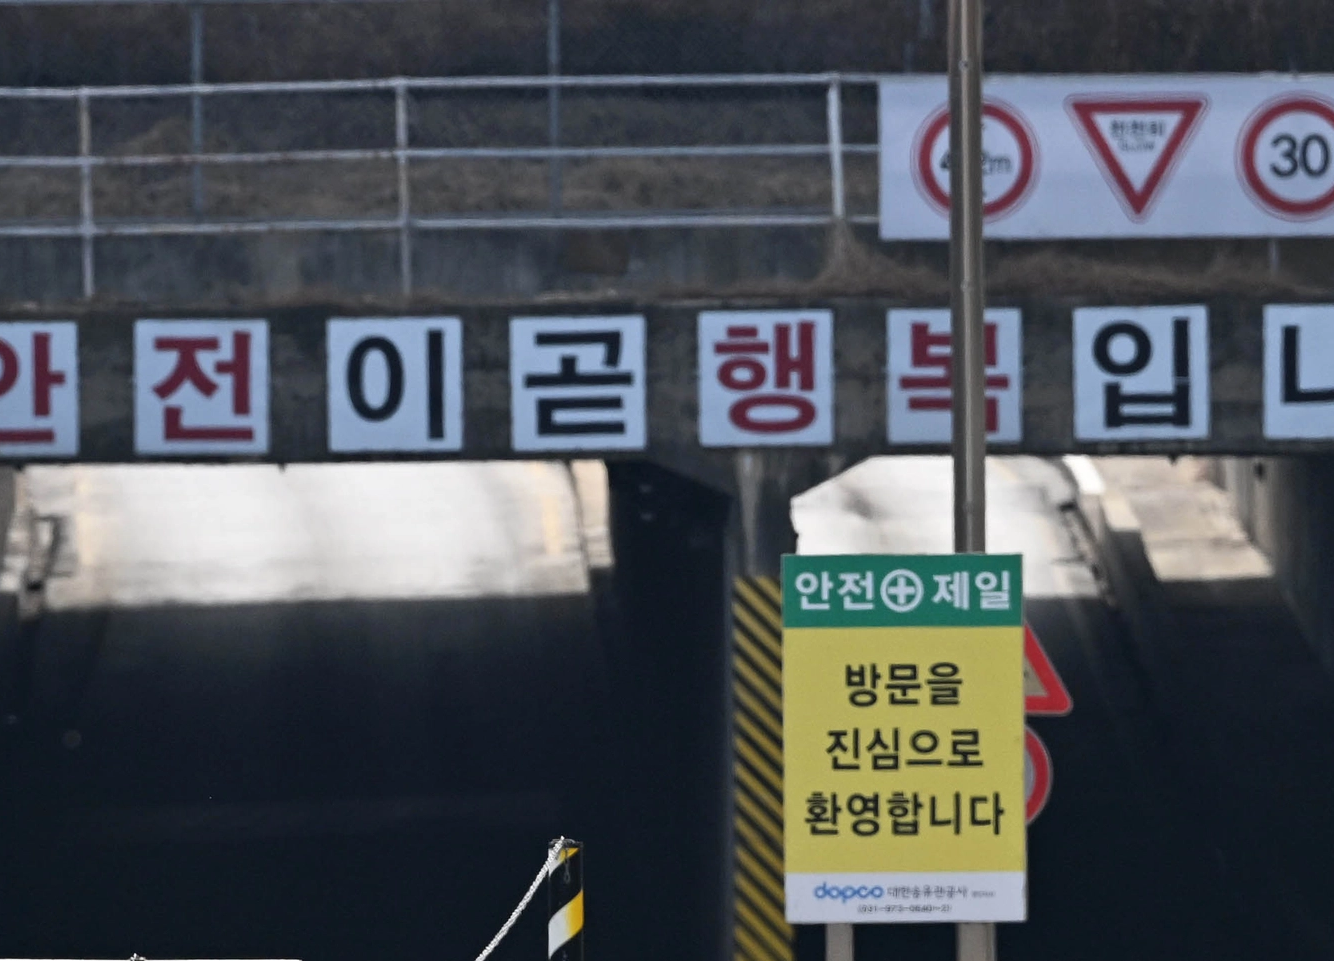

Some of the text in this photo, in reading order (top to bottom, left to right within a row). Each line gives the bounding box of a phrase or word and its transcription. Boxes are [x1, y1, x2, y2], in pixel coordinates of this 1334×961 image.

[1269, 132, 1331, 179] 30
[795, 569, 1012, 611] 안전 제일
[845, 662, 963, 708] 방문을
[825, 727, 984, 772] 진심으로
[804, 791, 1005, 837] 환영합니다
[814, 881, 884, 904] dopco
